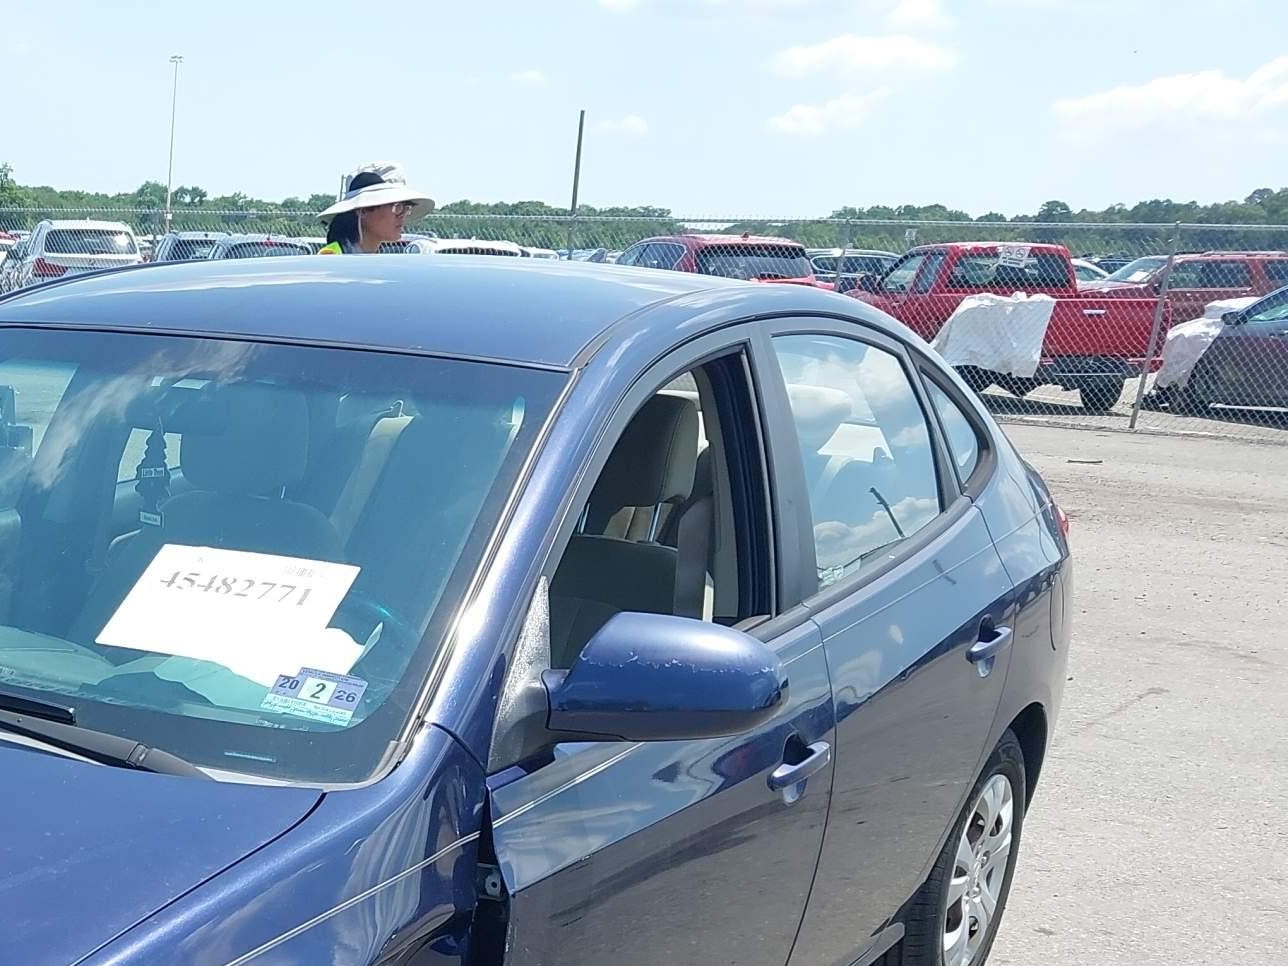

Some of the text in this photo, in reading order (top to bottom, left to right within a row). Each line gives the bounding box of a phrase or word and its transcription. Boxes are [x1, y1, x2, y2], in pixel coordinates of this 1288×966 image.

[160, 571, 312, 605] 45482771
[278, 677, 300, 691] 20
[309, 682, 327, 699] 2
[335, 689, 358, 703] 26
